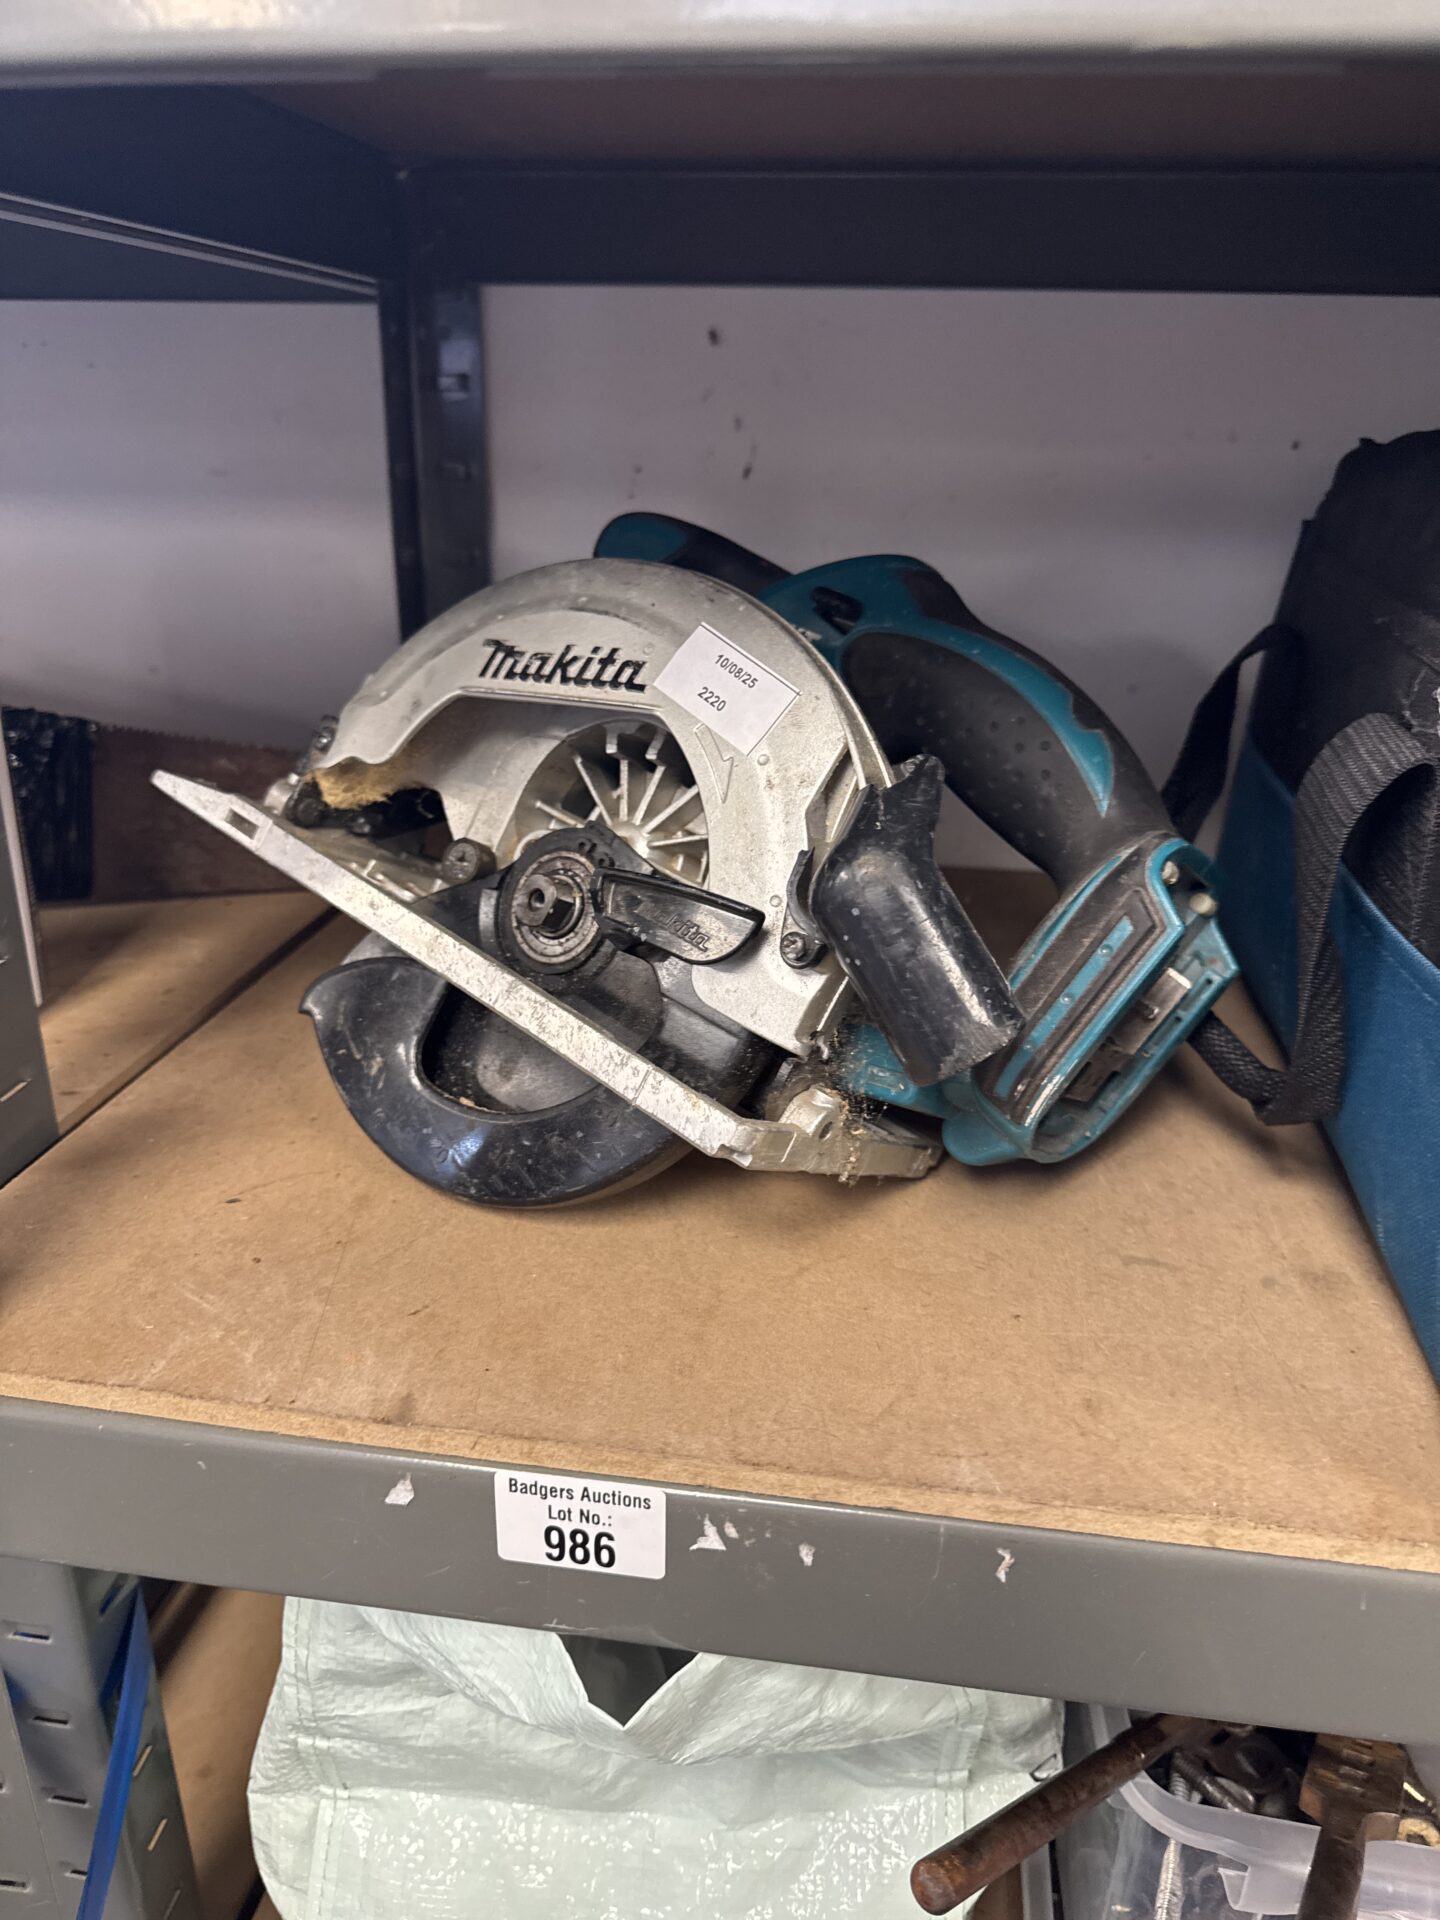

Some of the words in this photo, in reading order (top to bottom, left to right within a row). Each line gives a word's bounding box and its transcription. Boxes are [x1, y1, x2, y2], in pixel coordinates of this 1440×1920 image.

[478, 638, 647, 693] Makita
[715, 654, 758, 688] 10/08/25
[697, 686, 727, 711] 2220
[508, 1477, 575, 1500] Badgers
[580, 1486, 652, 1510] Auctions
[548, 1505, 572, 1522] Lot
[579, 1508, 612, 1527] No.:
[544, 1525, 616, 1568] 986
